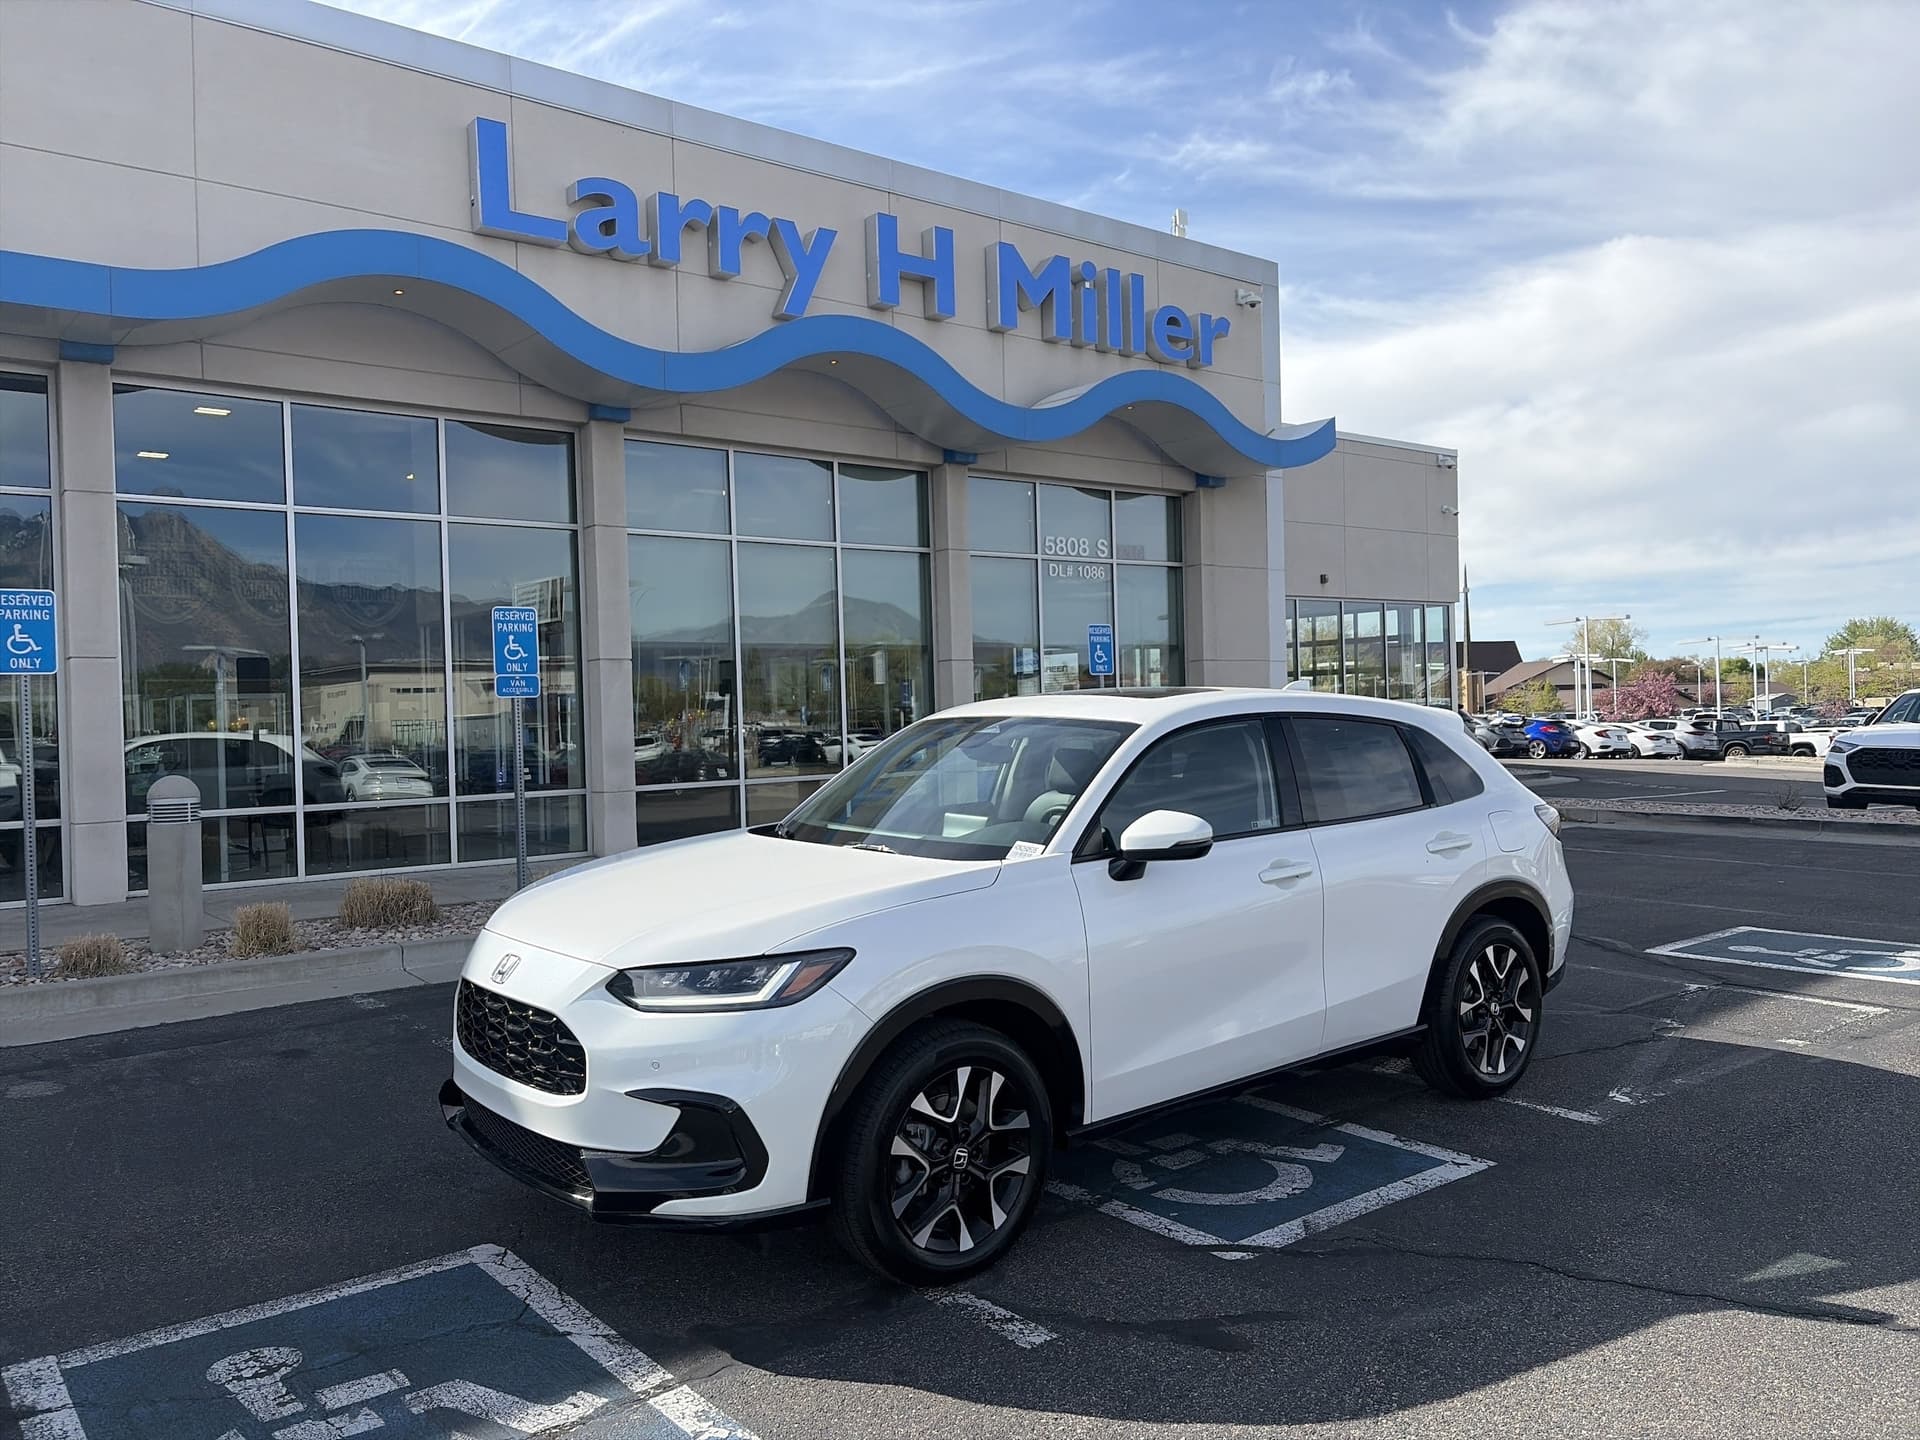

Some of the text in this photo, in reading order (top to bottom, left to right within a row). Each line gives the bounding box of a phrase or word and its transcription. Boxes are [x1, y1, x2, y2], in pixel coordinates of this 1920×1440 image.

[469, 117, 1230, 369] Larry H Miller
[1045, 536, 1109, 557] 5808 S
[1049, 563, 1105, 580] DL# 1086
[0, 594, 53, 607] ESERVED
[494, 611, 535, 621] RESERVED
[497, 623, 533, 633] PARKING
[9, 657, 41, 669] ONLY
[506, 663, 528, 672] ONLY
[510, 679, 526, 687] VAN
